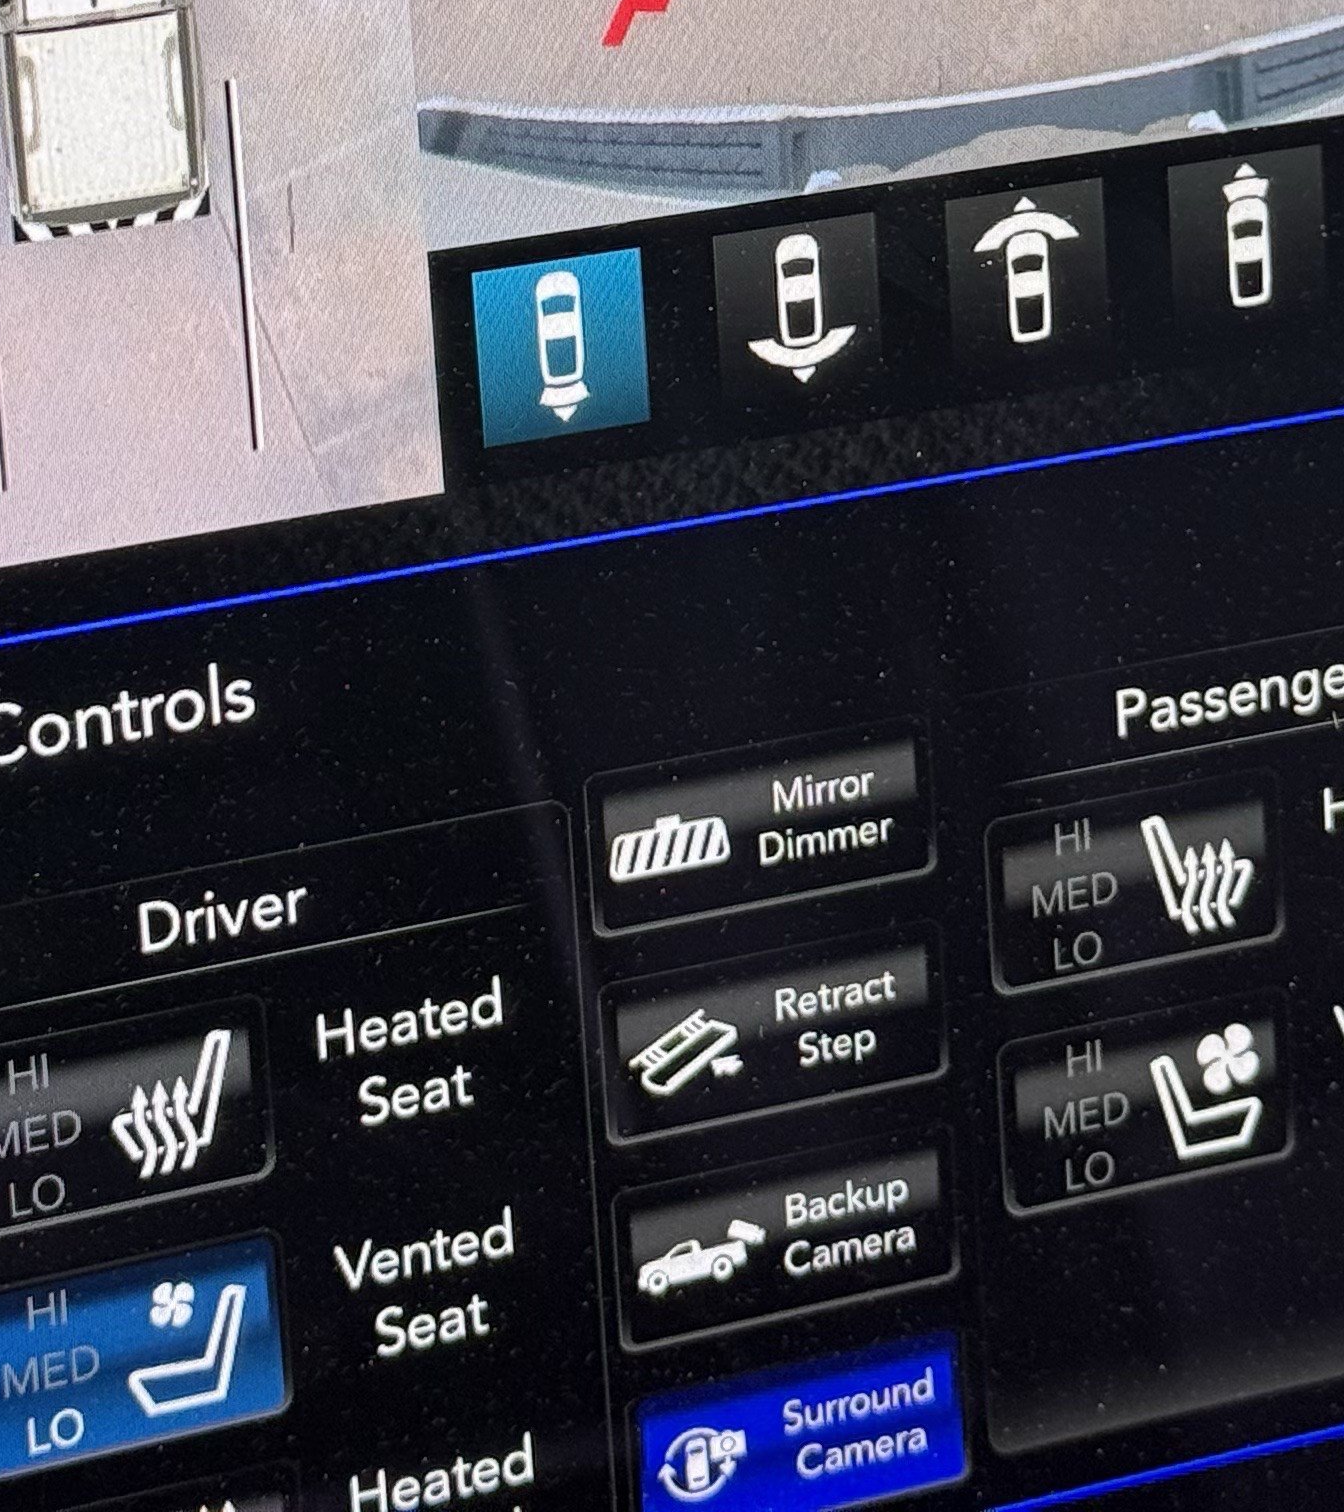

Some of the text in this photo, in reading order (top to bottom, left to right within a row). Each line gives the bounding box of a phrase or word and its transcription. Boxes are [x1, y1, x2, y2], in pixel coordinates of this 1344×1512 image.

[772, 771, 875, 814] Mirror
[757, 810, 895, 869] Dimmer
[1054, 818, 1091, 855] HI
[1031, 872, 1118, 918] MED
[137, 887, 308, 954] Driver
[1053, 931, 1103, 970] LO
[315, 975, 504, 1061] Heated
[774, 969, 897, 1021] Retract
[798, 1027, 877, 1070] Step
[1066, 1039, 1103, 1078] HI
[7, 1053, 49, 1096] HI
[359, 1064, 474, 1126] Seat
[1044, 1090, 1130, 1140] MED
[1065, 1150, 1115, 1192] LO
[9, 1174, 66, 1219] LO
[785, 1178, 909, 1228] Backup
[334, 1205, 515, 1292] Vented
[783, 1224, 917, 1276] Camera
[26, 1289, 68, 1332] HI
[375, 1294, 490, 1359] Seat
[1, 1344, 101, 1399] MED
[782, 1367, 935, 1435] Surround
[26, 1408, 85, 1457] LO
[795, 1424, 929, 1480] Camera
[349, 1431, 536, 1512] Heated
